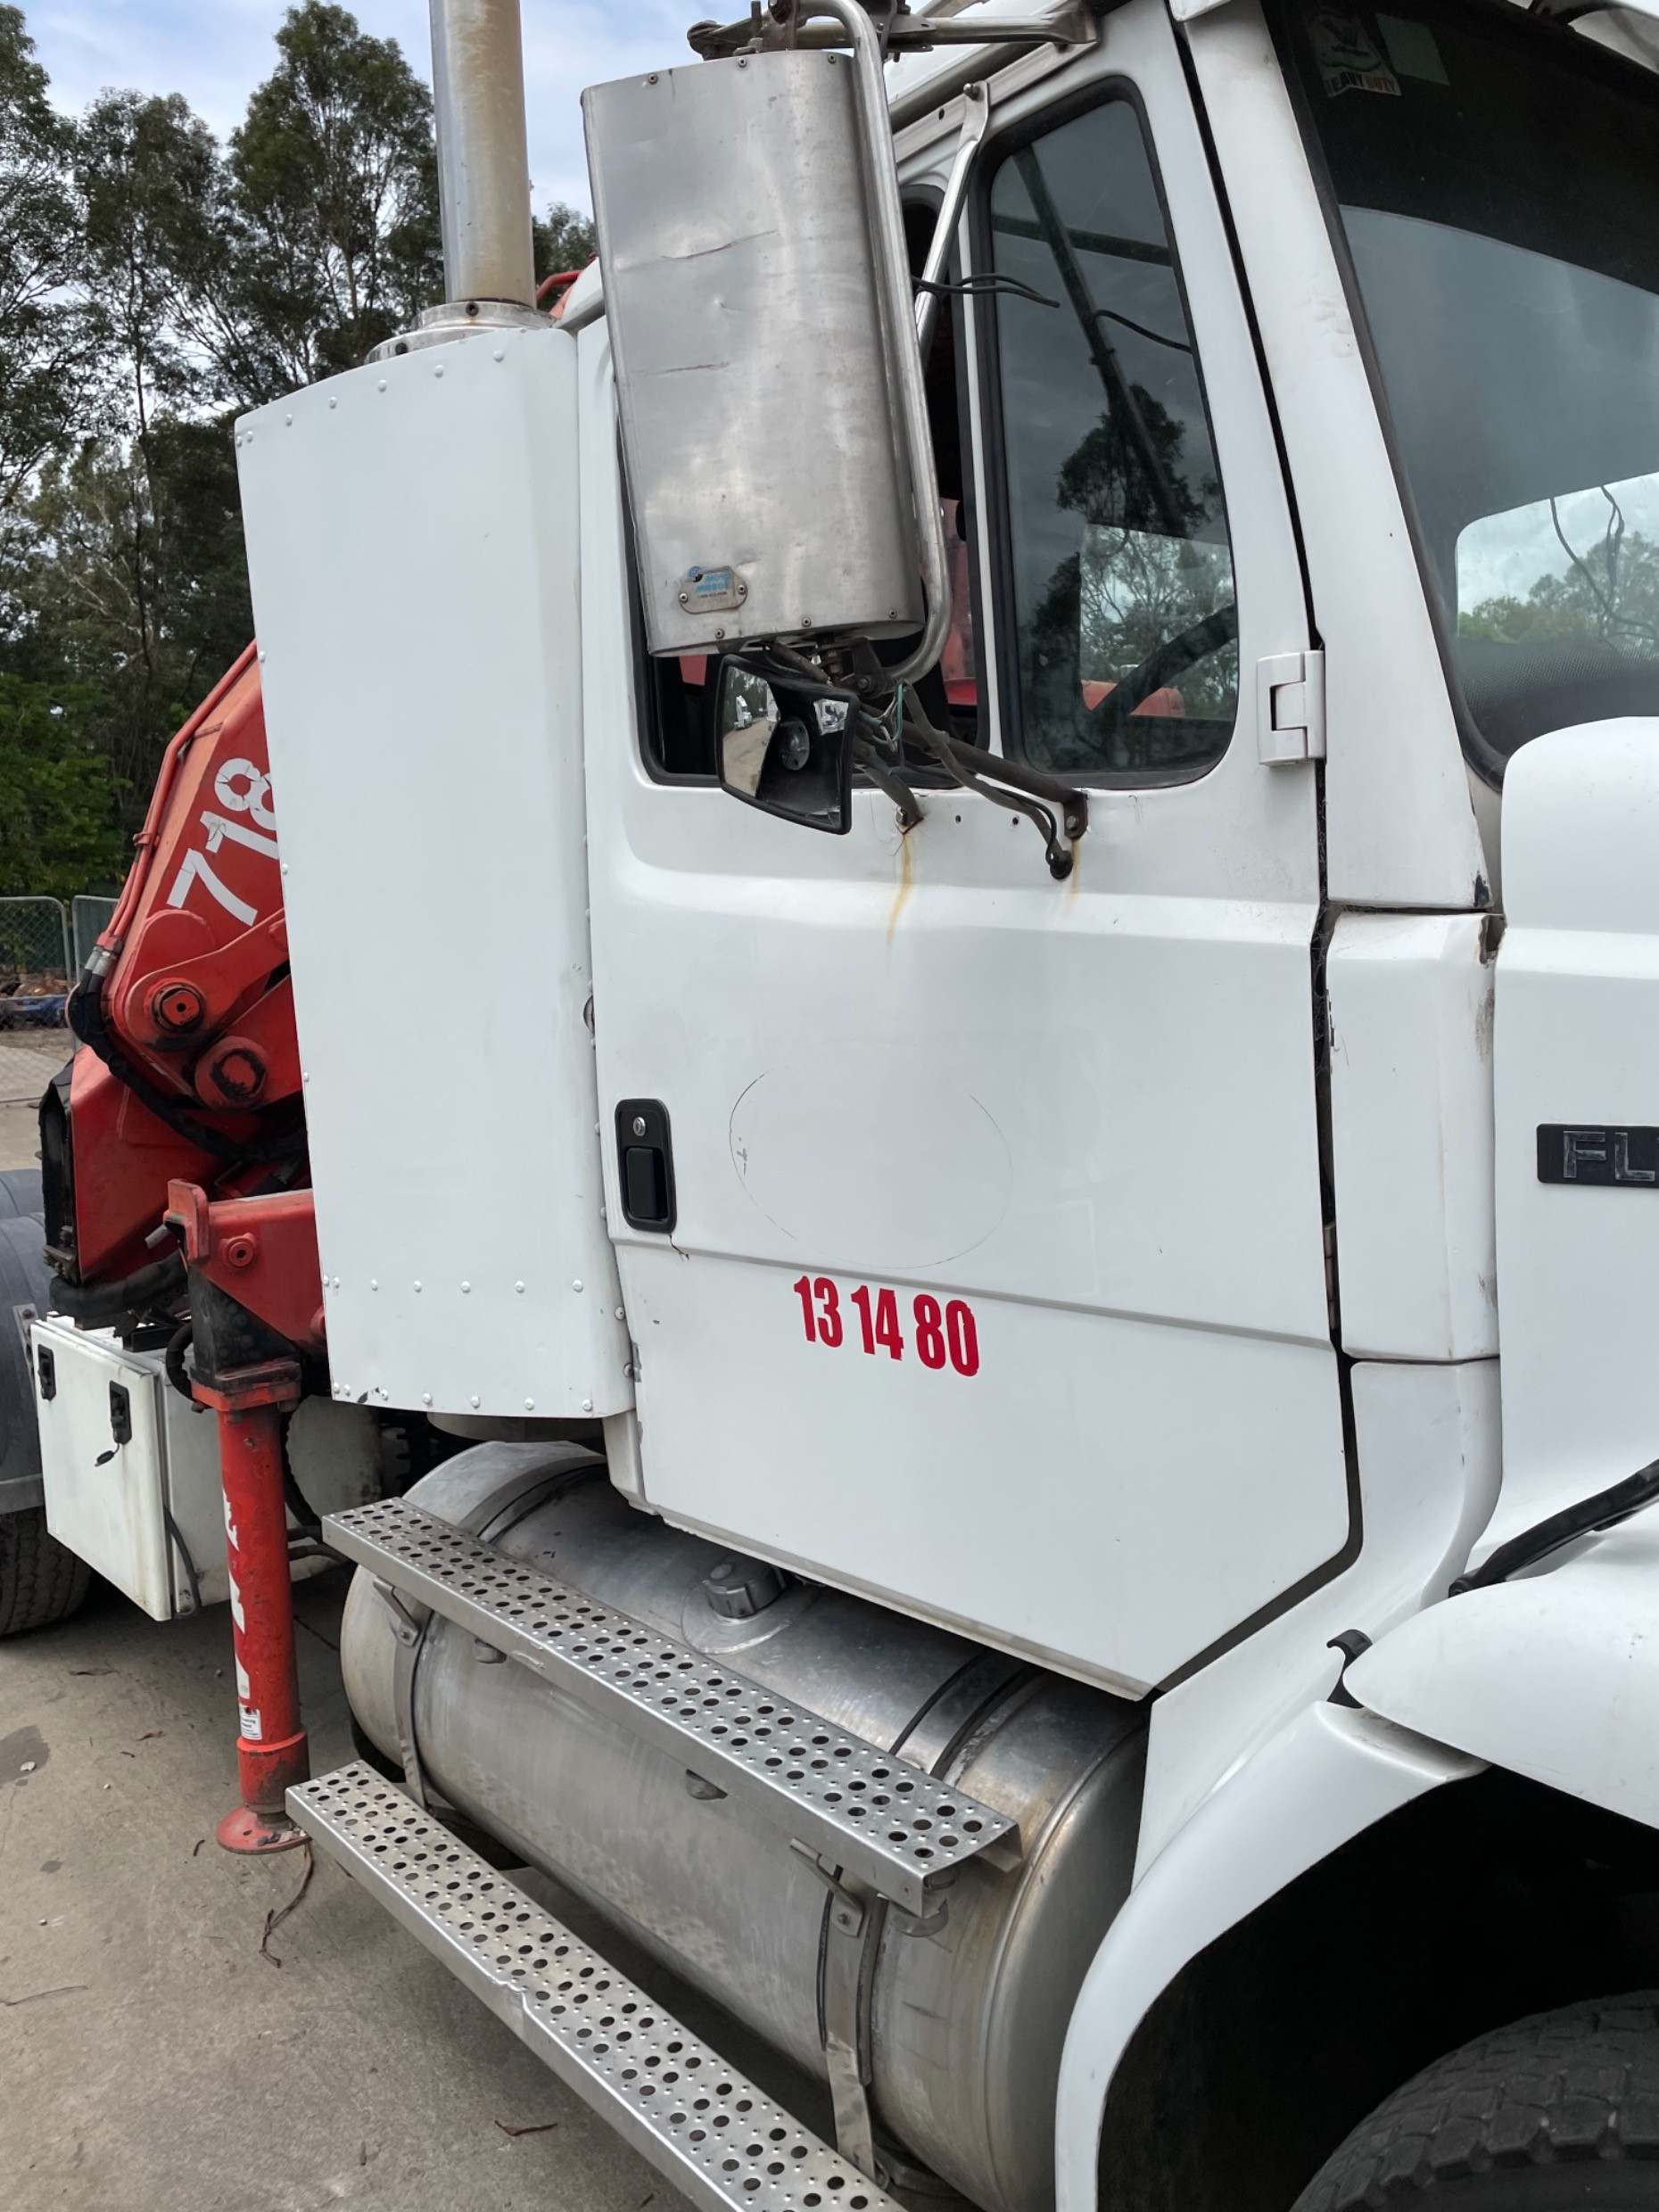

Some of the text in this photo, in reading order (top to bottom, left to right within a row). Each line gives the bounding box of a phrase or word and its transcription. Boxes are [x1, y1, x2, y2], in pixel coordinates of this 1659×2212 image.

[793, 1275, 980, 1377] 13 14 80
